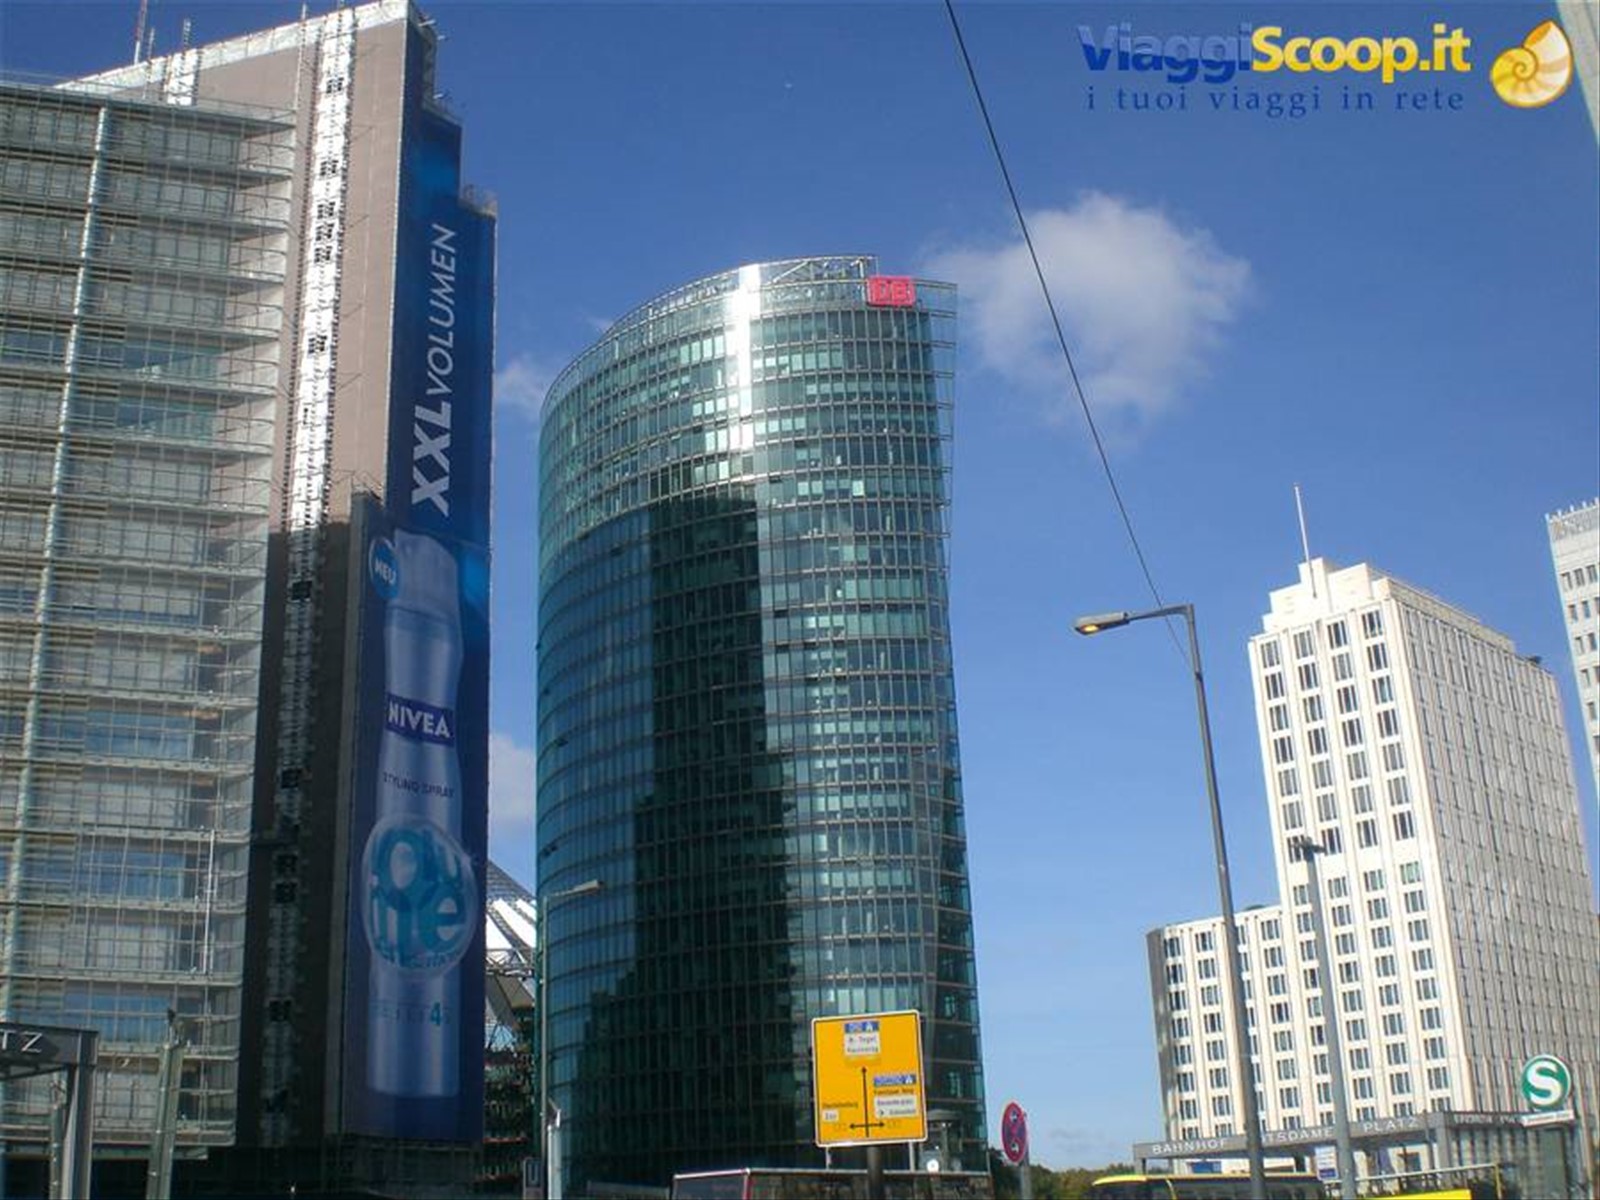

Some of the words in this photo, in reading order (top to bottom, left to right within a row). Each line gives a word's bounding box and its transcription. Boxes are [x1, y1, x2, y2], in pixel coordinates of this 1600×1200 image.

[426, 223, 457, 396] VOLUMEN
[411, 401, 451, 517] XXL
[388, 701, 450, 738] NIVEA
[1526, 1060, 1563, 1106] S
[1363, 1118, 1419, 1133] PLATZ
